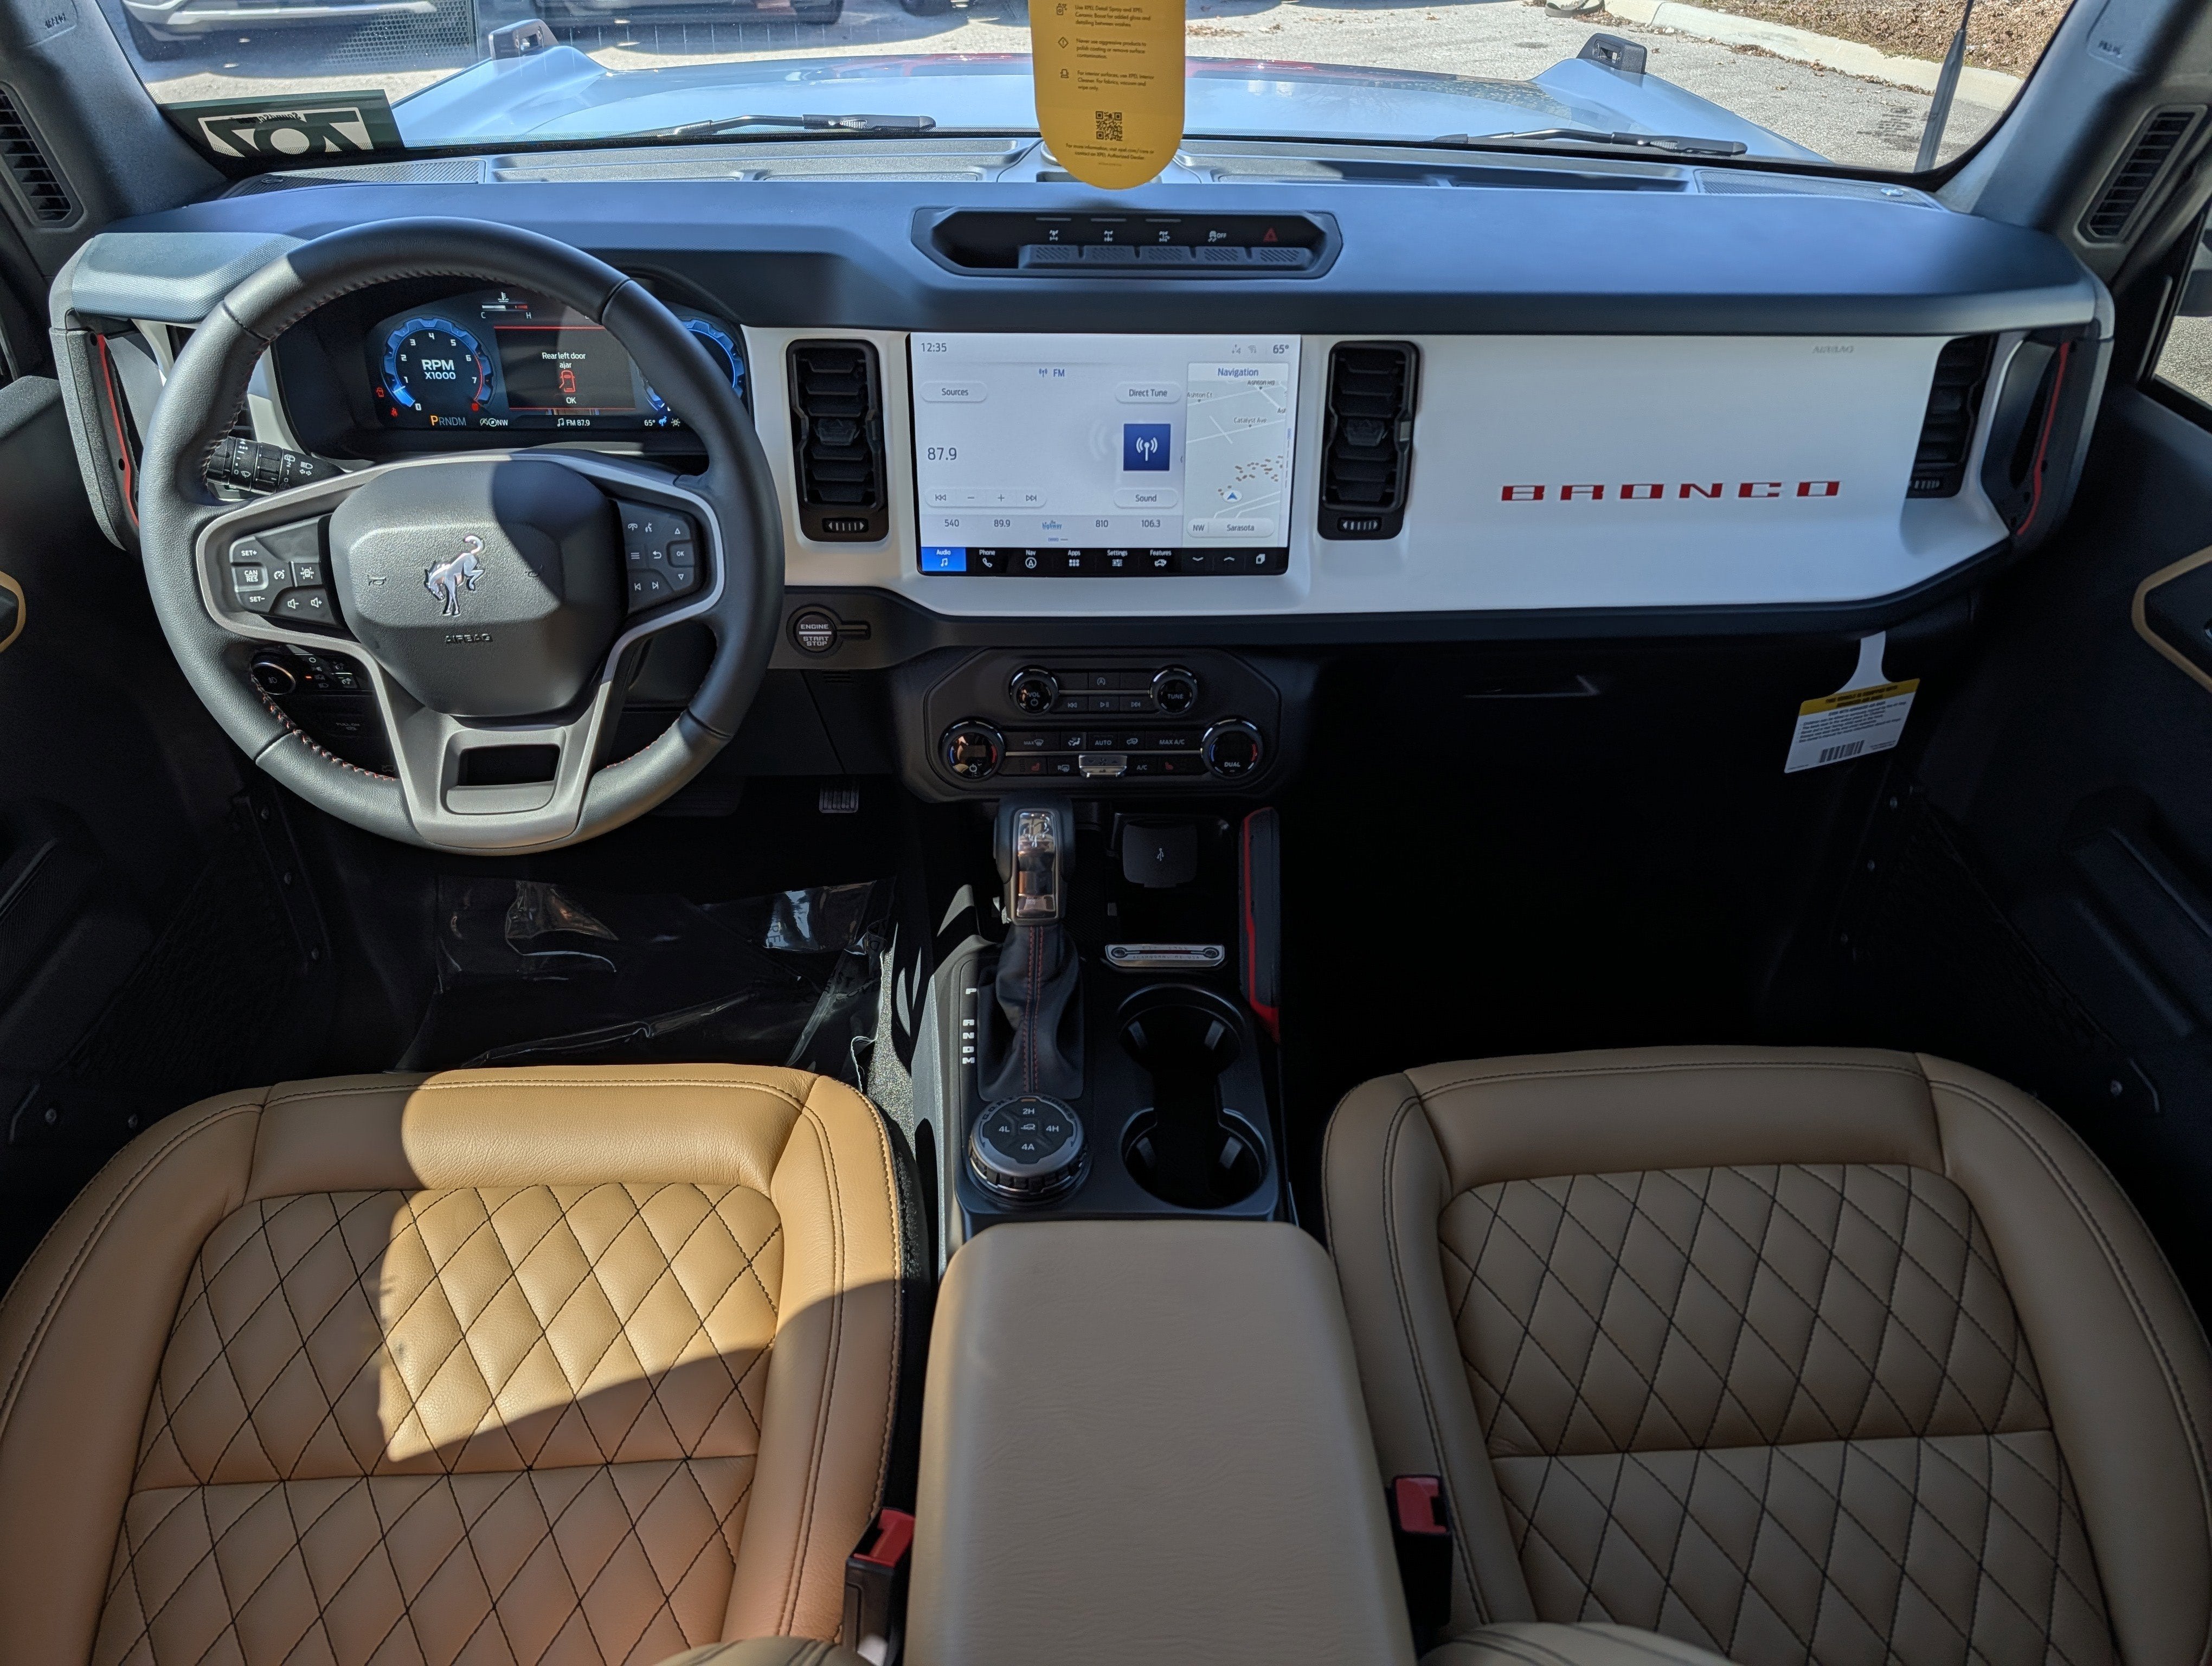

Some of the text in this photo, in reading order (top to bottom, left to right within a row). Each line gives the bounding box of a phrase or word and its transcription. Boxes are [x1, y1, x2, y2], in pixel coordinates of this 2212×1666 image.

[921, 342, 947, 353] 12:35
[1272, 344, 1289, 354] 65°
[421, 360, 455, 370] RPM
[425, 371, 456, 380] X1000
[1053, 369, 1065, 377] FM
[1218, 368, 1259, 378] Navigation
[941, 387, 969, 396] Sources
[1129, 388, 1168, 397] Direct Tune
[415, 403, 422, 411] 0
[927, 447, 957, 461] 87.9
[1501, 480, 1840, 501] BRONCO
[1135, 494, 1157, 502] Sound
[944, 519, 960, 527] 540
[994, 519, 1011, 528] 89.9
[1096, 520, 1109, 528] 810
[1141, 520, 1161, 528] 106.3
[445, 635, 493, 644] AIRBAG
